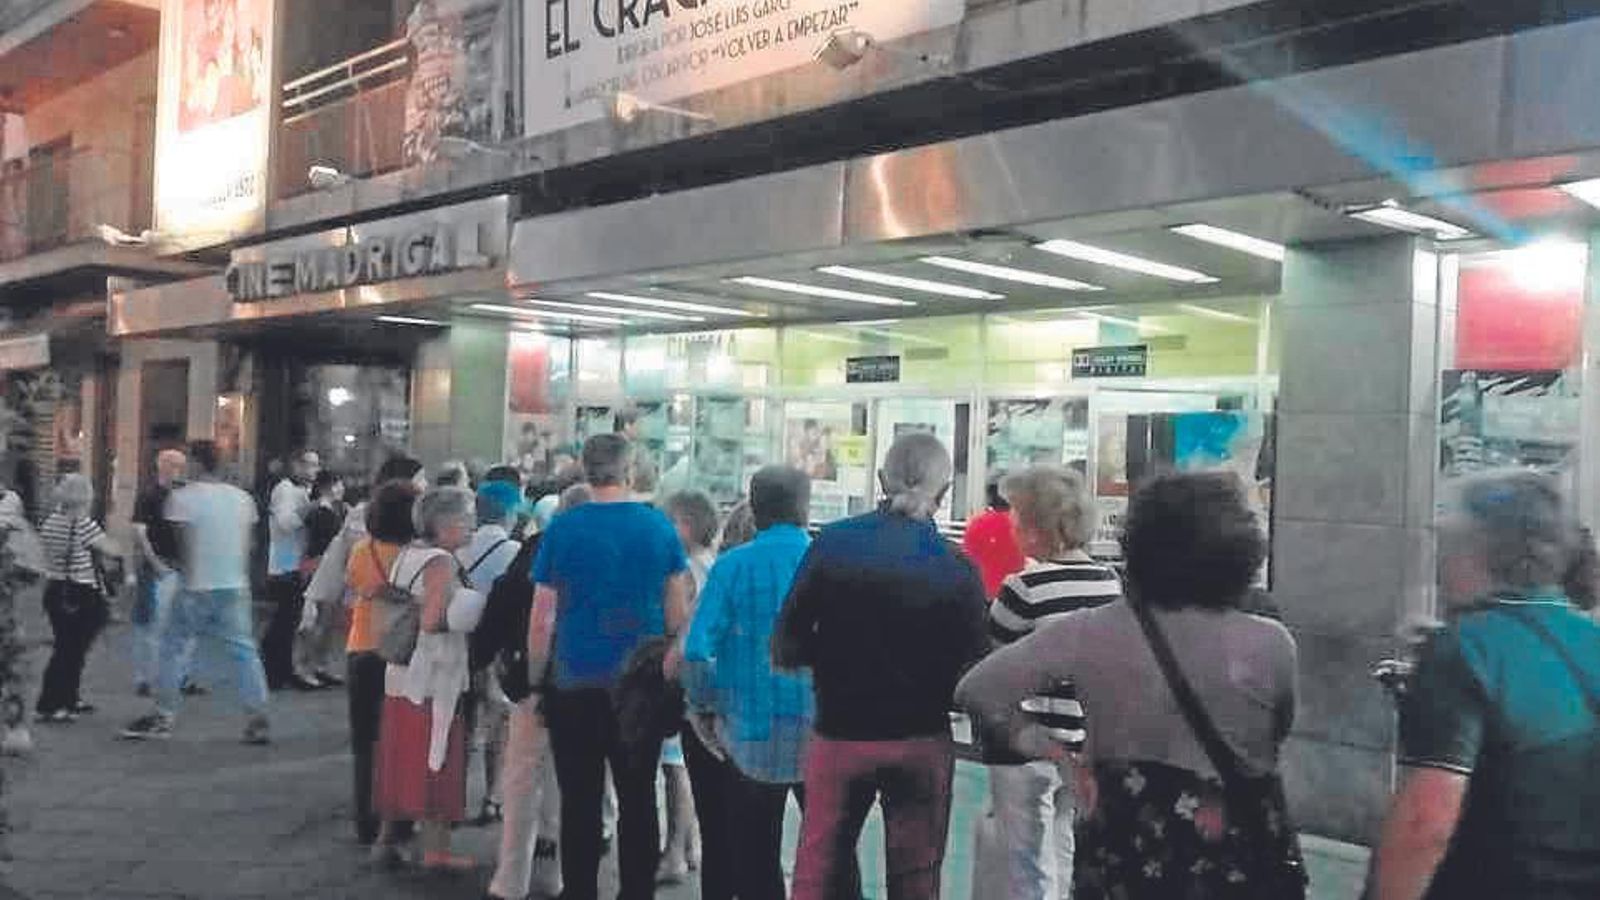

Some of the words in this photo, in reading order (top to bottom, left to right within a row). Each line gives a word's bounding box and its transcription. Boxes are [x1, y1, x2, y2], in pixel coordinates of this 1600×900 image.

[545, 0, 580, 59] EL
[725, 5, 749, 31] LUIS
[775, 26, 783, 43] A
[225, 261, 287, 302] CINE
[294, 221, 492, 294] MADRIGAL
